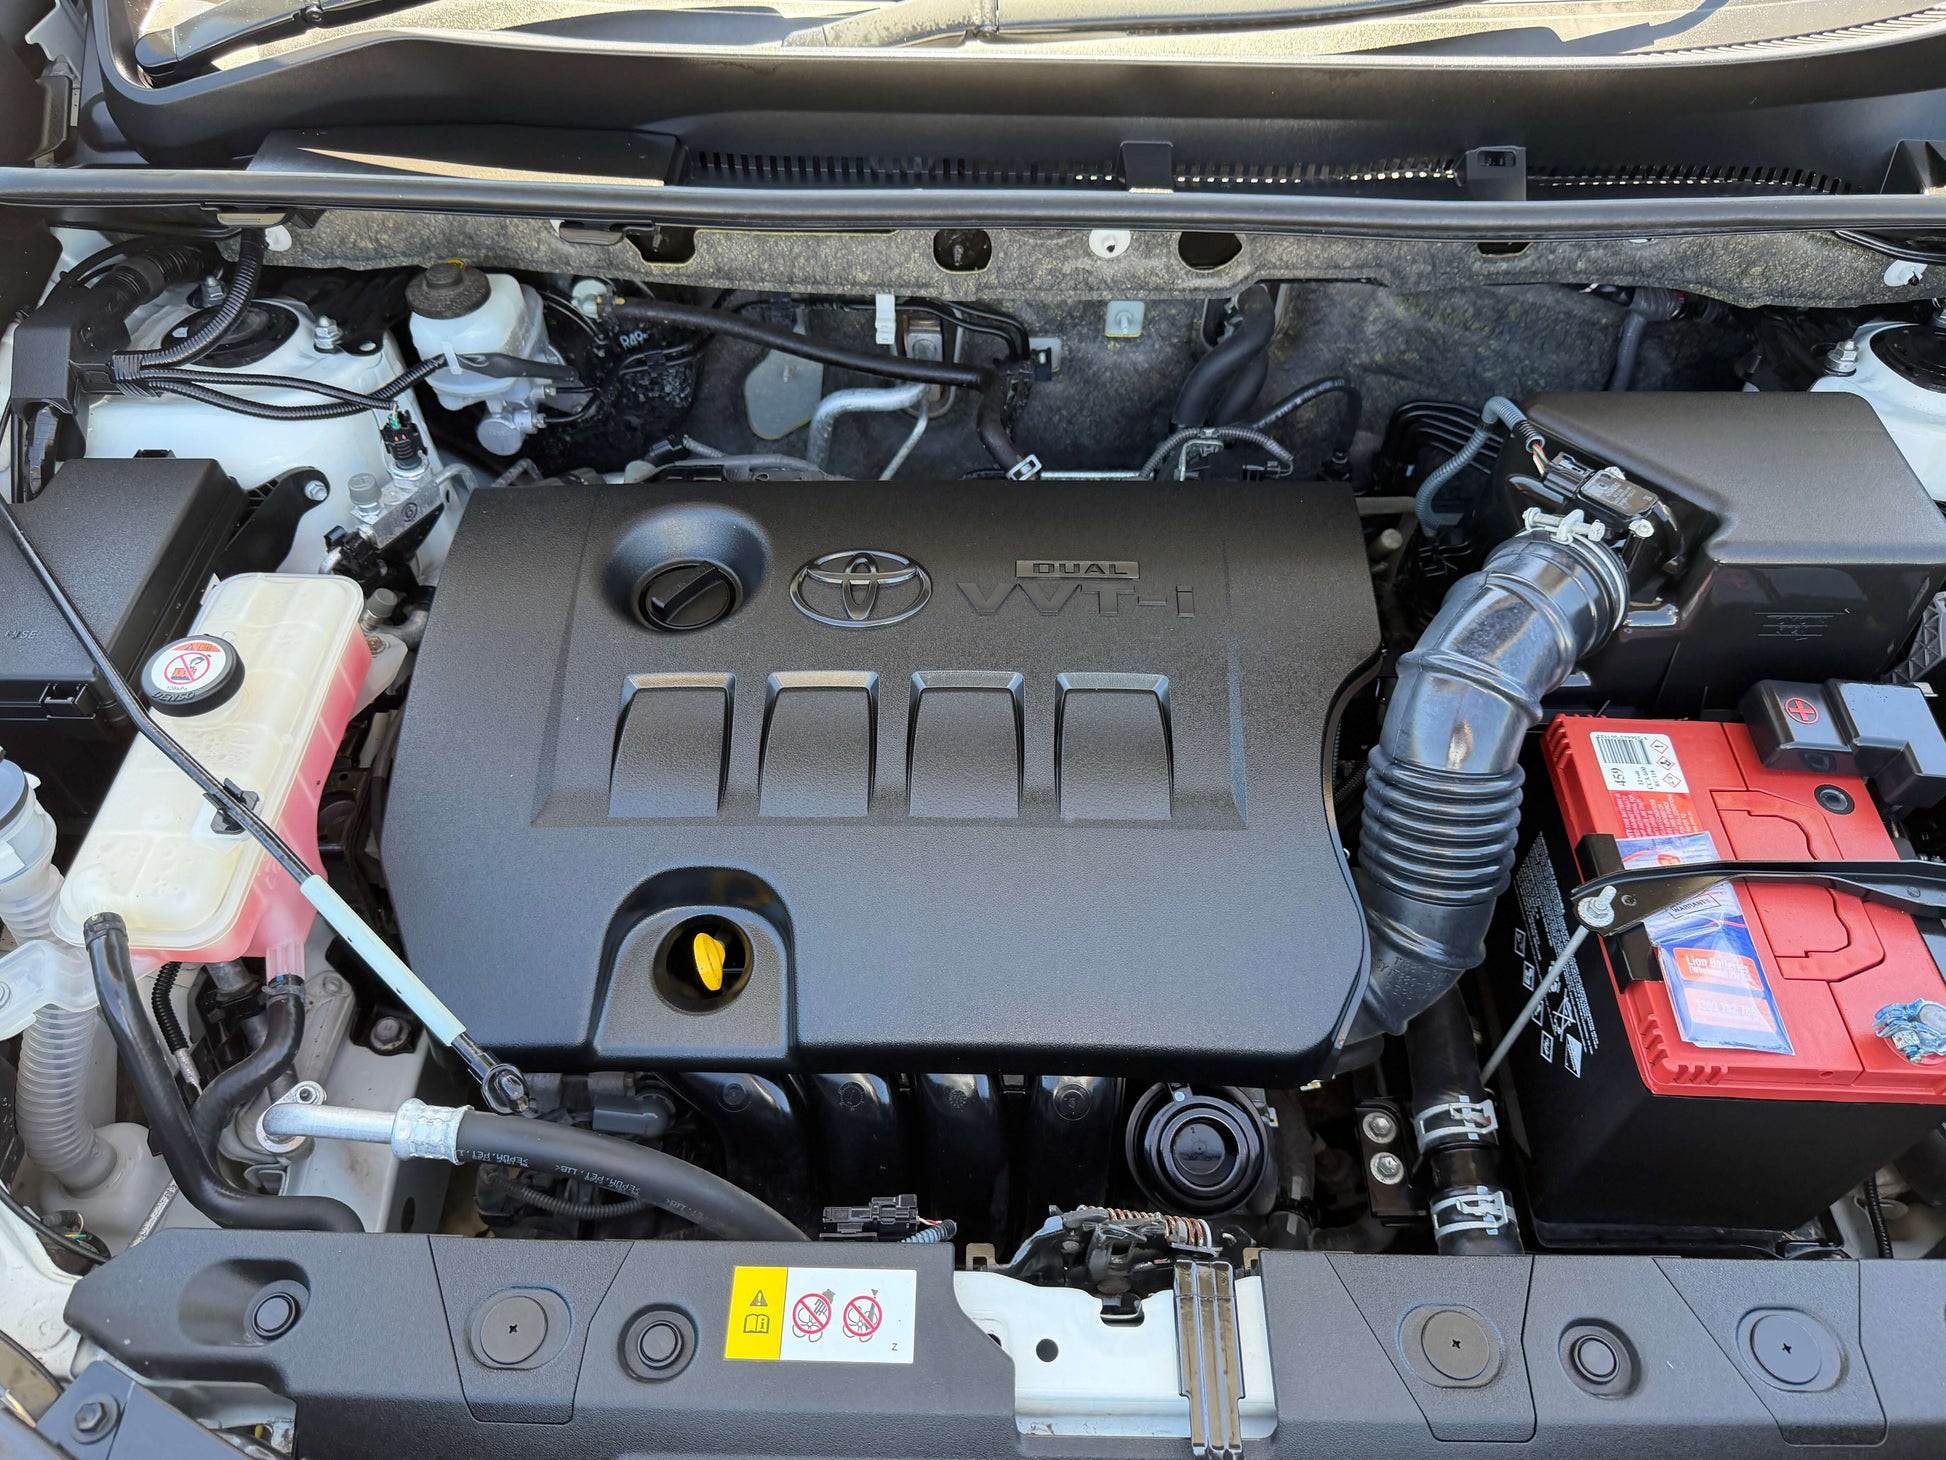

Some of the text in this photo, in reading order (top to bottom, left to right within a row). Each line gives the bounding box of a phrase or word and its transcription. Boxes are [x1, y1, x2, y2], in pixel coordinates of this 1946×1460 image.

[1032, 562, 1129, 576] DUAL
[955, 582, 1196, 618] VVT-i
[151, 691, 196, 703] DENSO
[1611, 767, 1627, 787] 459
[1685, 954, 1708, 967] Lion
